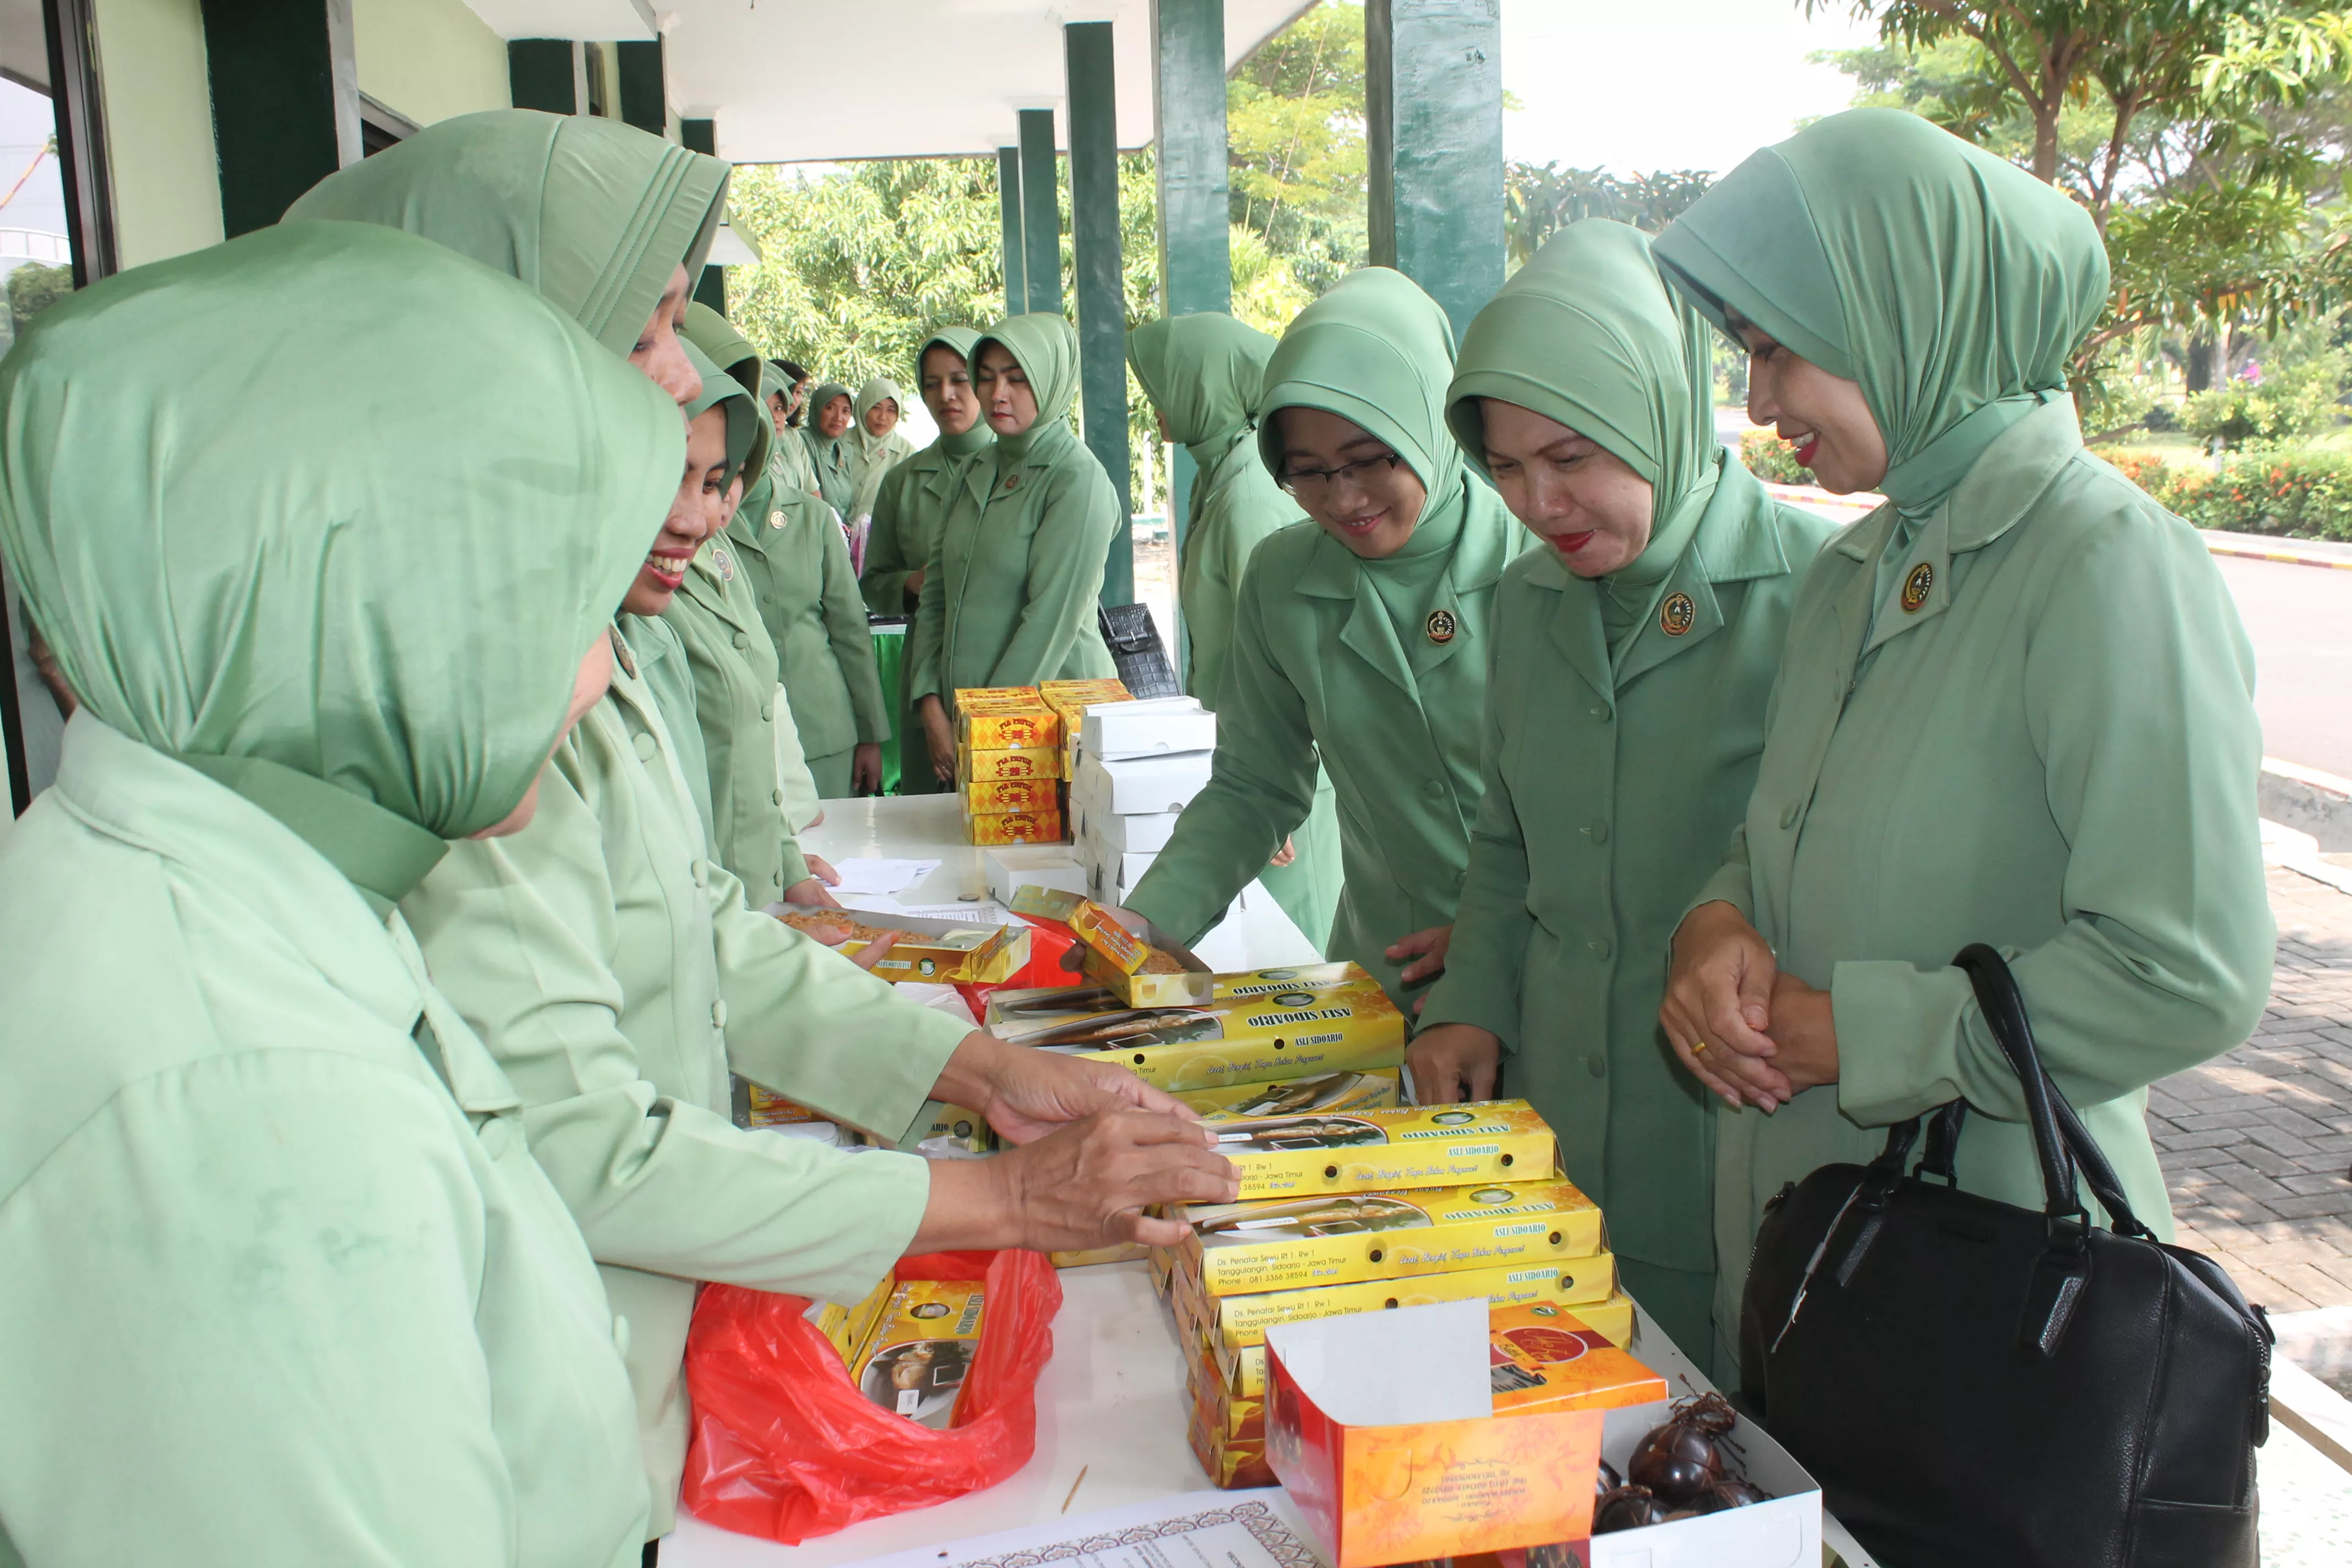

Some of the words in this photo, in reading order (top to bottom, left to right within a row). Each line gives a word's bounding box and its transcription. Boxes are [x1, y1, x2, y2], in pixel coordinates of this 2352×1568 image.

[1233, 982, 1300, 994] SIDOARJO
[1248, 1010, 1319, 1027] SIDOARJO
[1321, 1008, 1352, 1019] ASLI
[1295, 1036, 1309, 1047] ASLI
[1310, 1032, 1343, 1044] SIDOARJO
[930, 1123, 949, 1132] ARJO
[1401, 1127, 1475, 1139] SIDOARJO
[1478, 1125, 1510, 1133] ASLI
[1448, 1147, 1463, 1156] ASLI
[1464, 1145, 1499, 1155] SIDOARJO
[1241, 1173, 1258, 1182] oarjo
[1494, 1227, 1510, 1237] ASLI
[1511, 1223, 1547, 1235] SIDOARJO
[1271, 1262, 1300, 1271] Sidoarjo
[1286, 1271, 1308, 1280] 38594
[1508, 1273, 1523, 1283] ASLI
[1524, 1268, 1559, 1280] SIDOARJO
[1288, 1313, 1317, 1321] Sidoarjo
[1235, 1329, 1259, 1337] Phone
